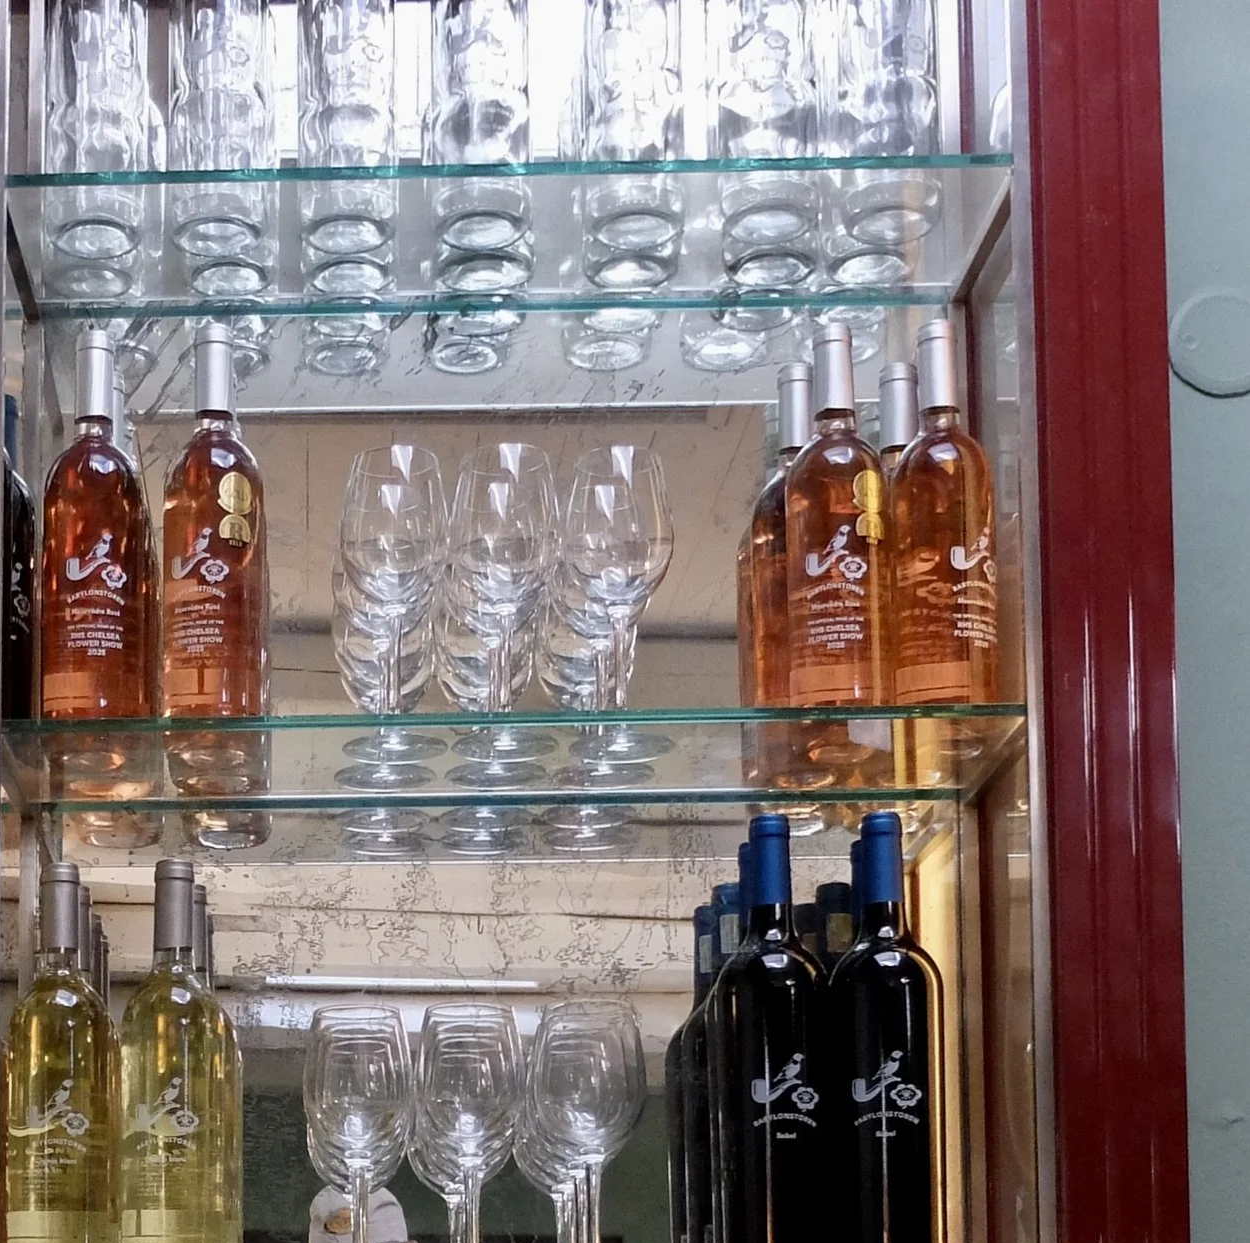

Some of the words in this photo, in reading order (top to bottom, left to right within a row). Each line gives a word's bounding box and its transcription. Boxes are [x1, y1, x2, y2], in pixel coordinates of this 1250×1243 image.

[66, 589, 125, 606] BABYLONSTOREN
[186, 627, 220, 636] CHELSEA
[825, 624, 860, 632] CHELSEA
[86, 631, 121, 641] CHELSEA
[954, 629, 983, 638] FLOWER
[199, 636, 224, 644] SHOW
[808, 633, 838, 645] FLOWER
[839, 632, 864, 640] SHOW
[67, 640, 99, 649] FLOWER
[101, 640, 124, 650] SHOW
